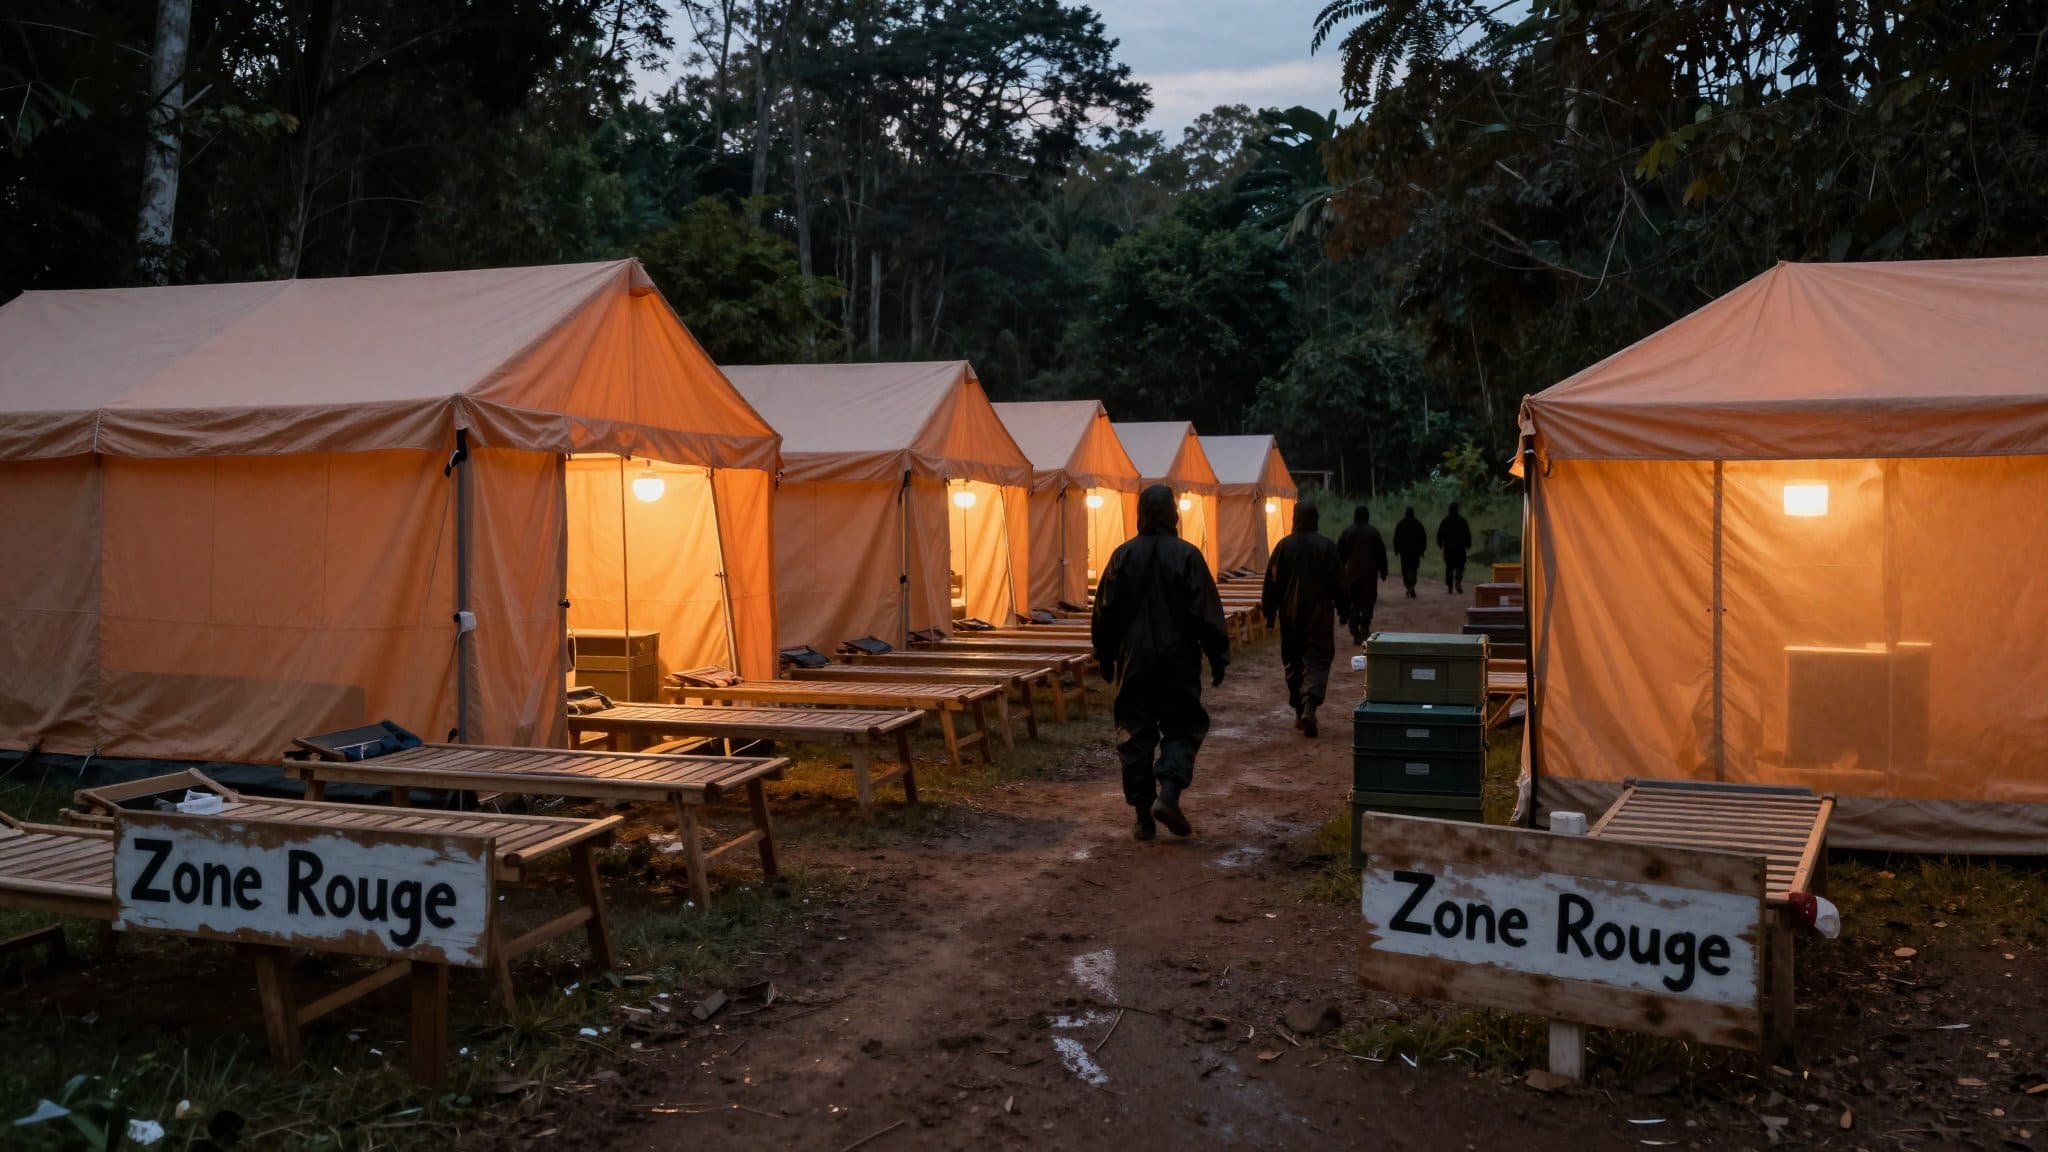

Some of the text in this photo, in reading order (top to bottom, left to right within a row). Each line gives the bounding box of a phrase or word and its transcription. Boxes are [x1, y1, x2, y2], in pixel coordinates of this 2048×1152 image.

[132, 838, 456, 947] Zone Rouge
[1389, 871, 1731, 992] Zone Rouge
